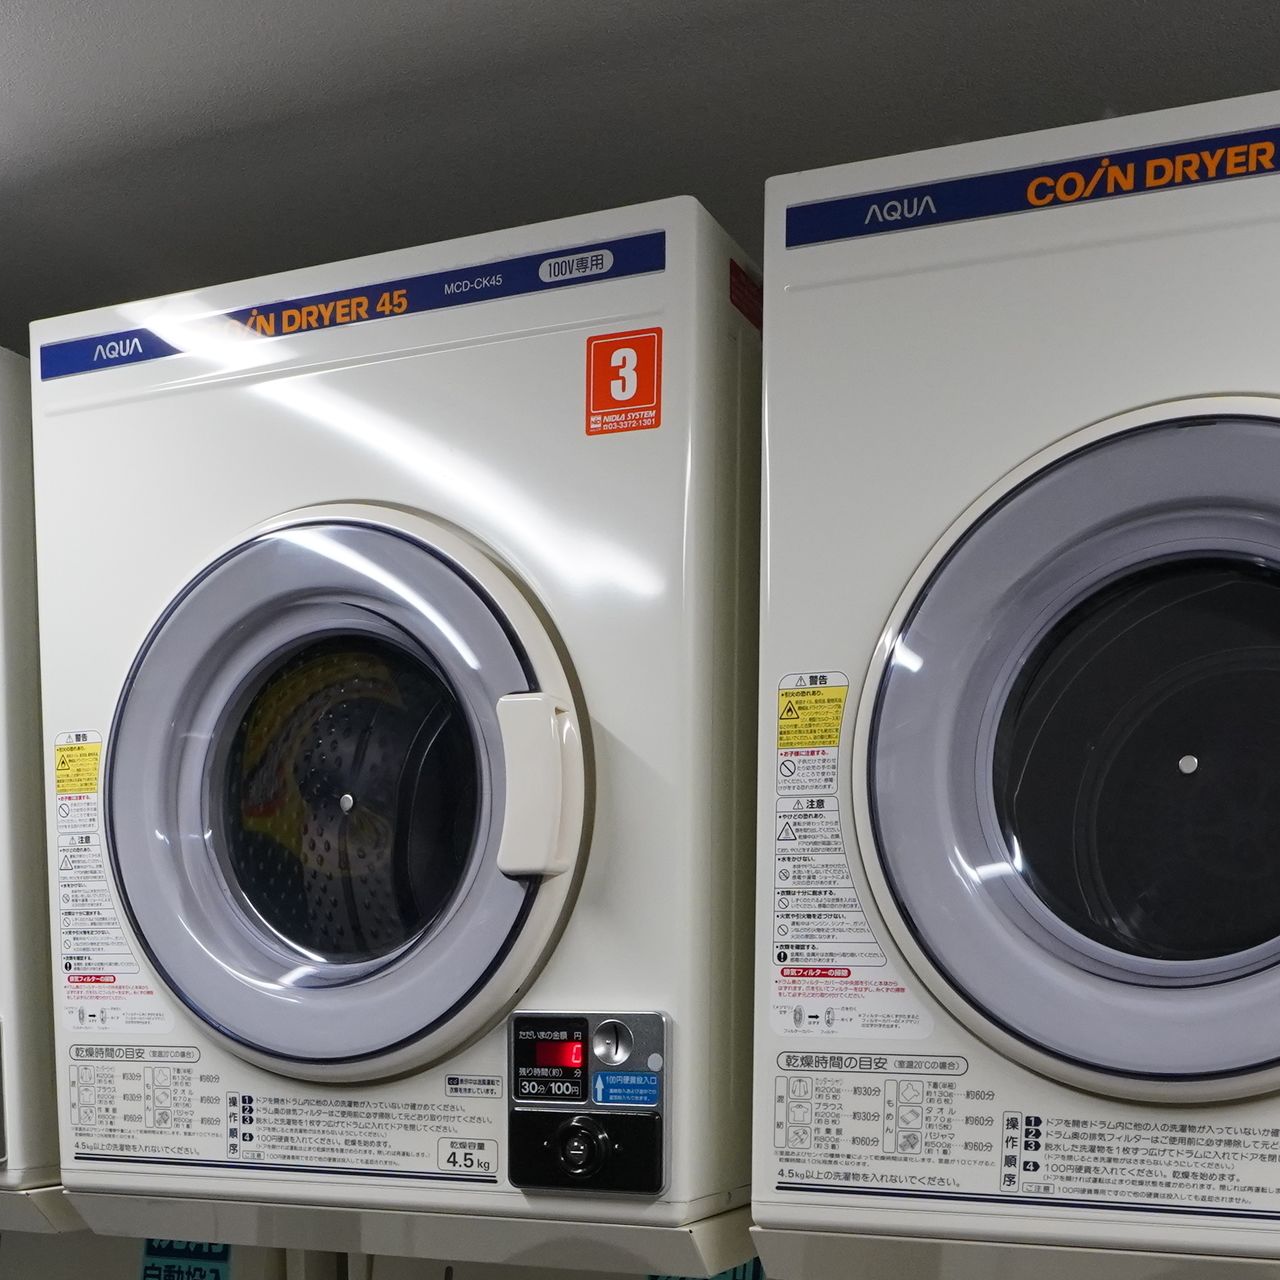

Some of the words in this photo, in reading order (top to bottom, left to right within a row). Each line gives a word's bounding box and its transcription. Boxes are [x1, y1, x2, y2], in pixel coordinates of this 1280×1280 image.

[1145, 141, 1275, 188] DRYER
[864, 195, 936, 224] AQUA
[547, 254, 604, 279] 100V専用
[444, 275, 503, 295] MCD-CK45
[281, 296, 368, 333] DRYER
[376, 289, 408, 316] 45
[93, 337, 142, 362] AQUA
[610, 348, 638, 401] 3
[627, 410, 656, 421] SYSTEM
[809, 675, 828, 685] 警告
[806, 799, 825, 809] 注意
[75, 1048, 145, 1059] 乾燥時間の目安
[785, 1055, 888, 1070] 乾燥時間の目安
[853, 1087, 881, 1096] 約30分
[852, 1112, 880, 1121] 約30分
[1003, 1117, 1018, 1186] 操作順序
